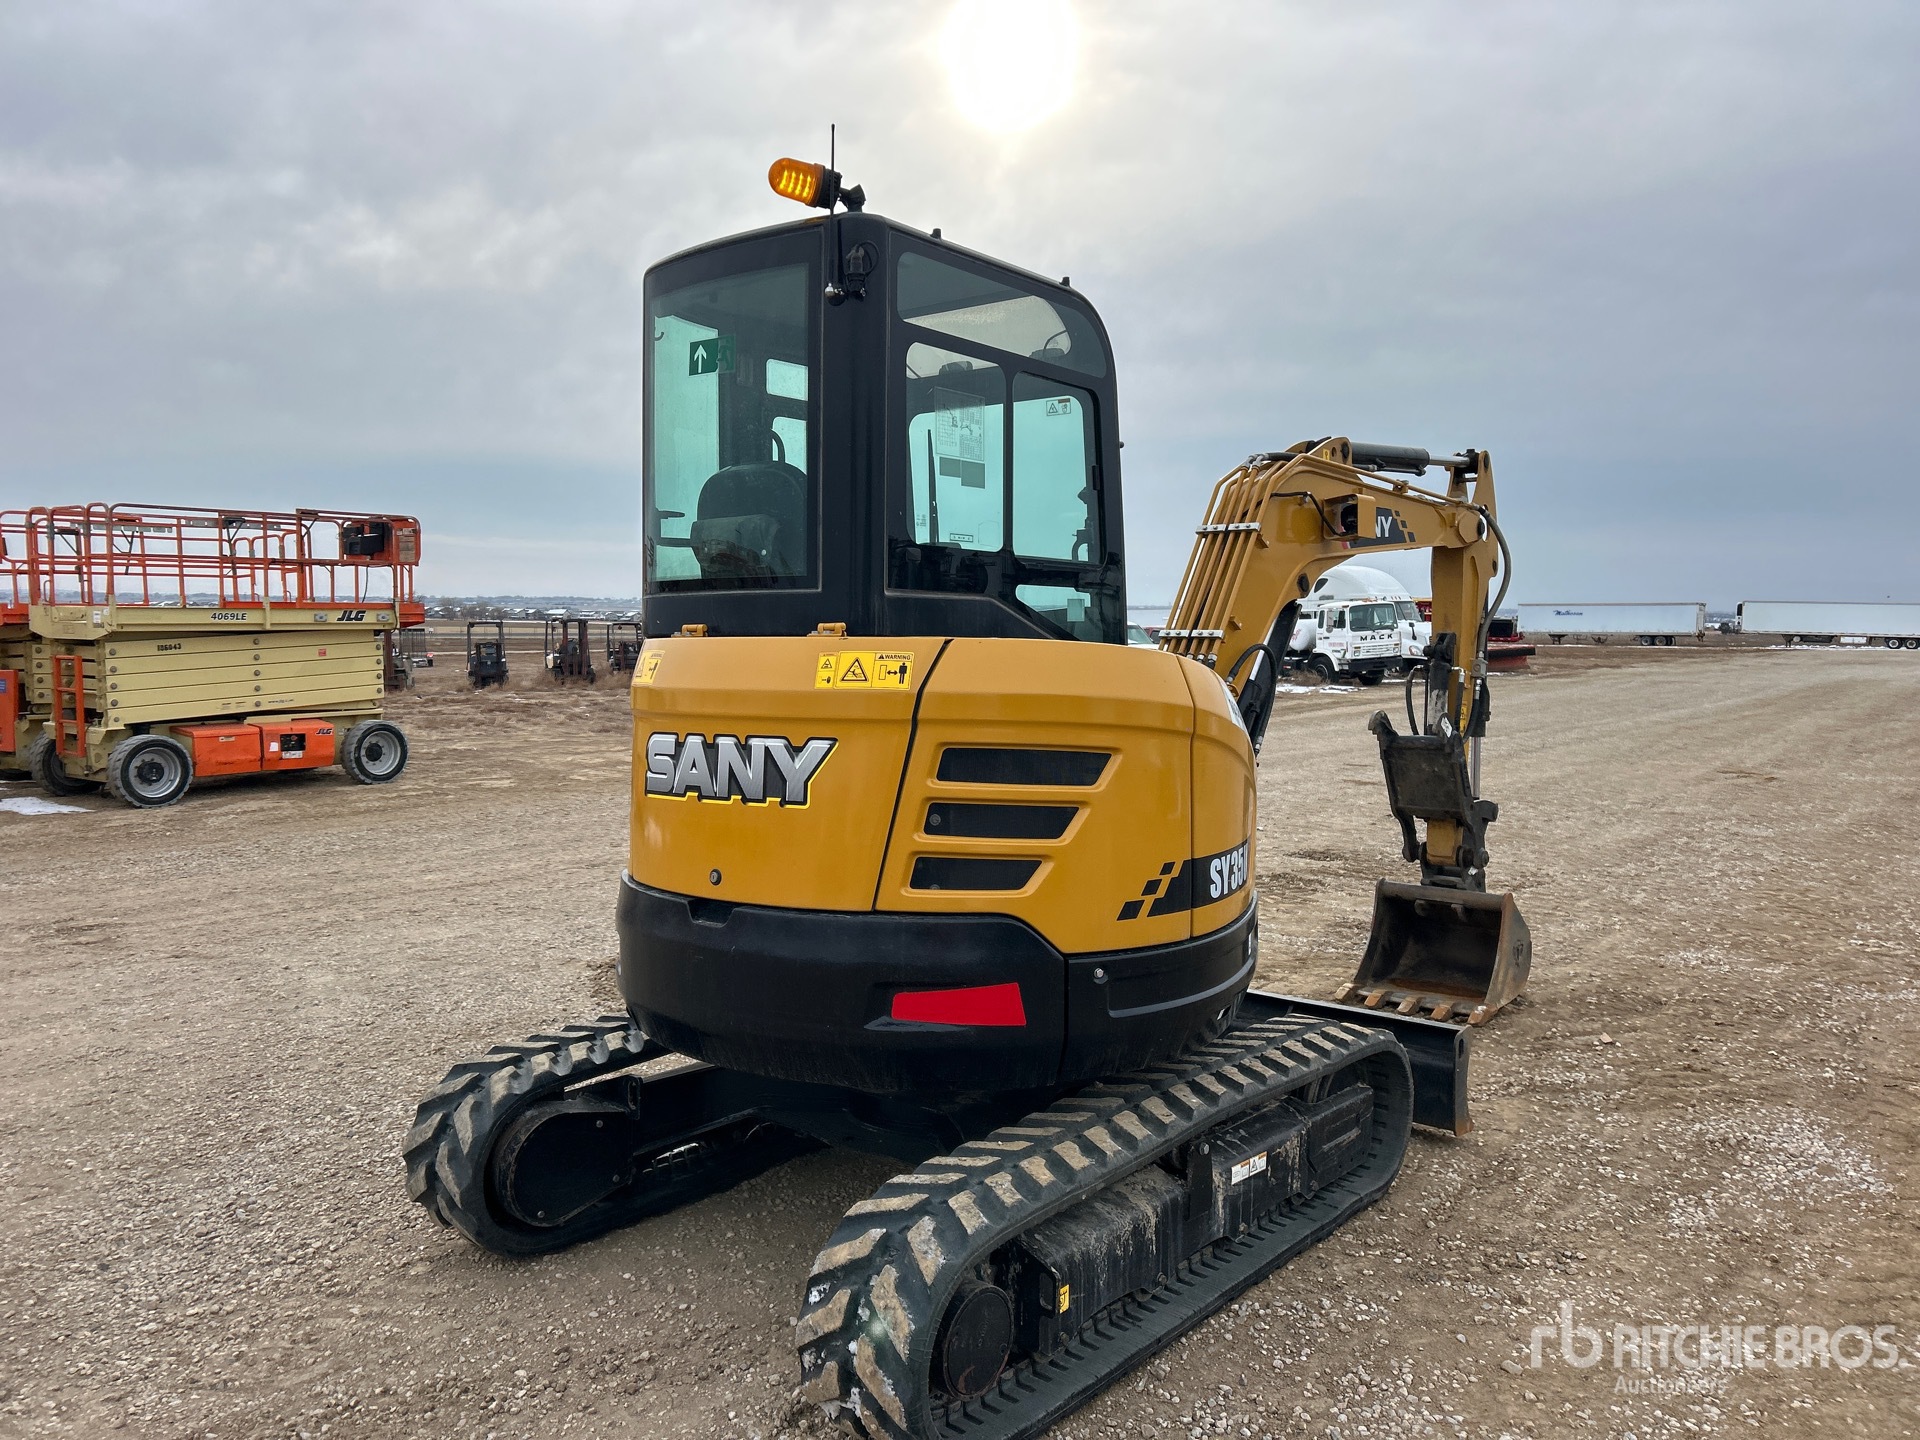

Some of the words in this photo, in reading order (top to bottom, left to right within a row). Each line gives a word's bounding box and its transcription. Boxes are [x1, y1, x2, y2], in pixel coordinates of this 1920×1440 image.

[210, 612, 248, 621] 4069LE
[336, 610, 367, 622] JLG
[1360, 633, 1393, 642] MACK
[646, 732, 837, 807] SANY
